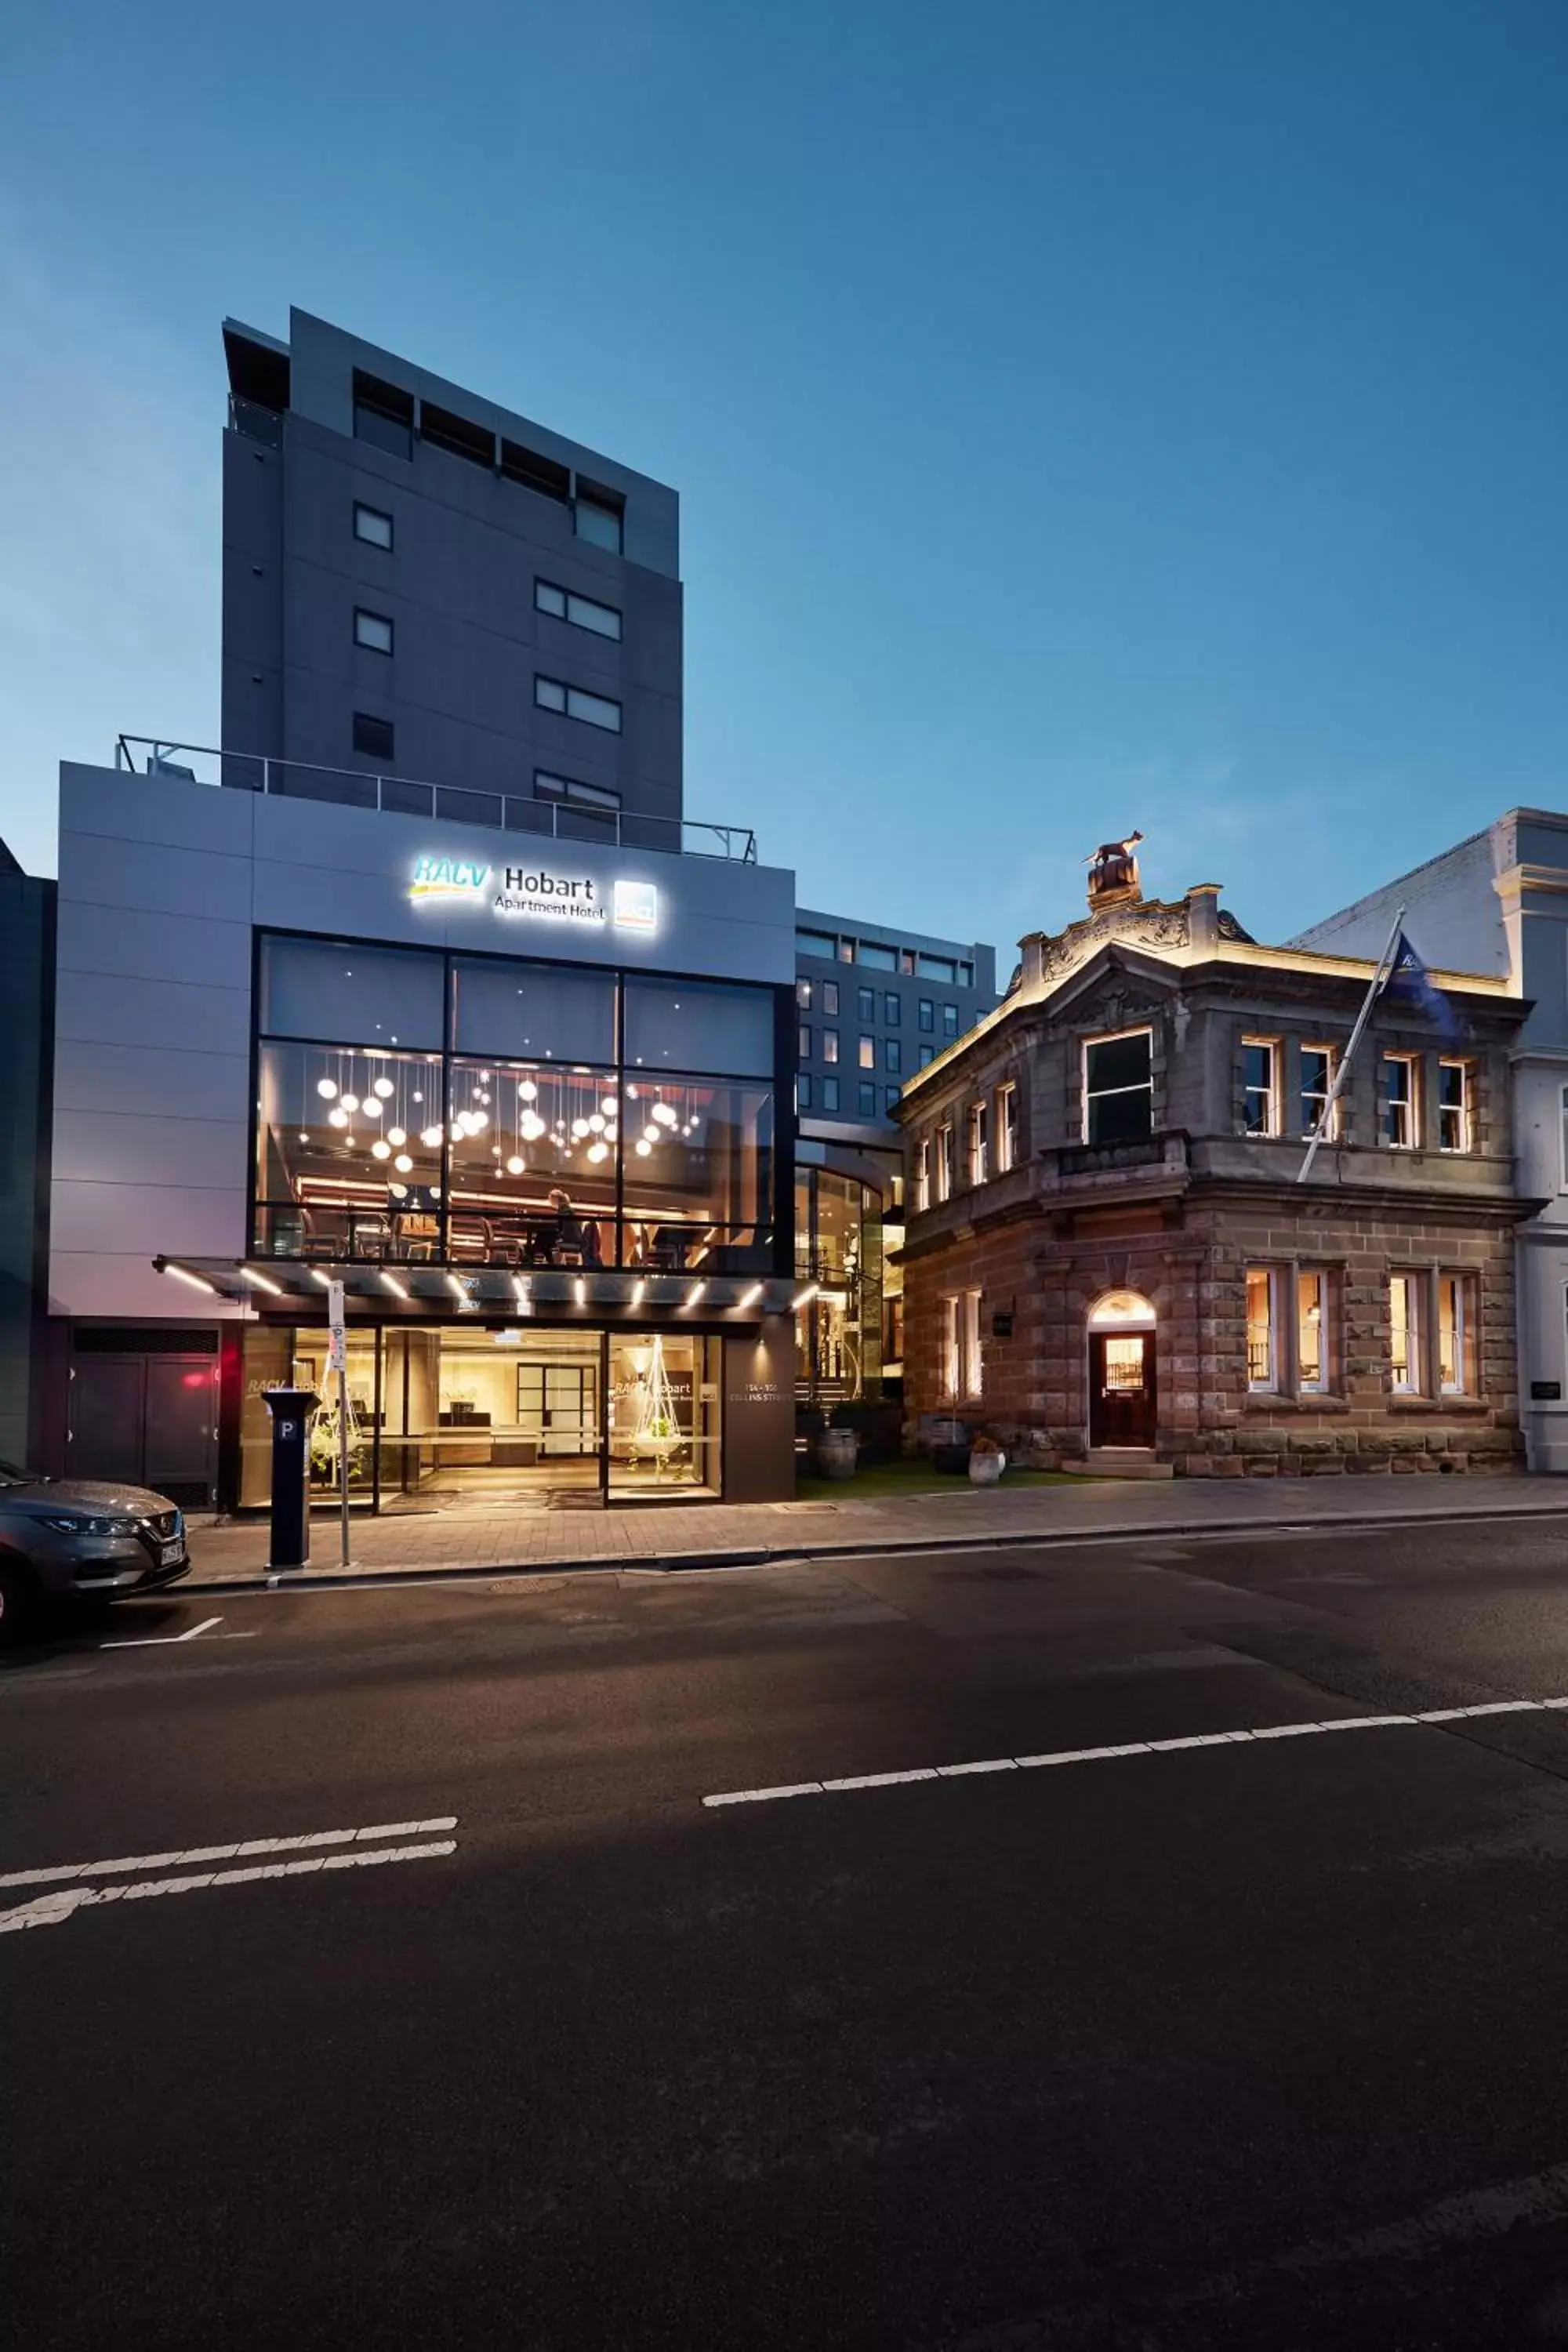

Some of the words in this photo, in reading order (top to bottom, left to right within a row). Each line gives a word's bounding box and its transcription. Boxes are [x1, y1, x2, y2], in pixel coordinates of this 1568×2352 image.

[414, 855, 488, 887] RACV
[506, 866, 593, 900] Hobart
[495, 895, 567, 916] Apartment
[570, 904, 605, 920] Hotel
[281, 1422, 293, 1437] P
